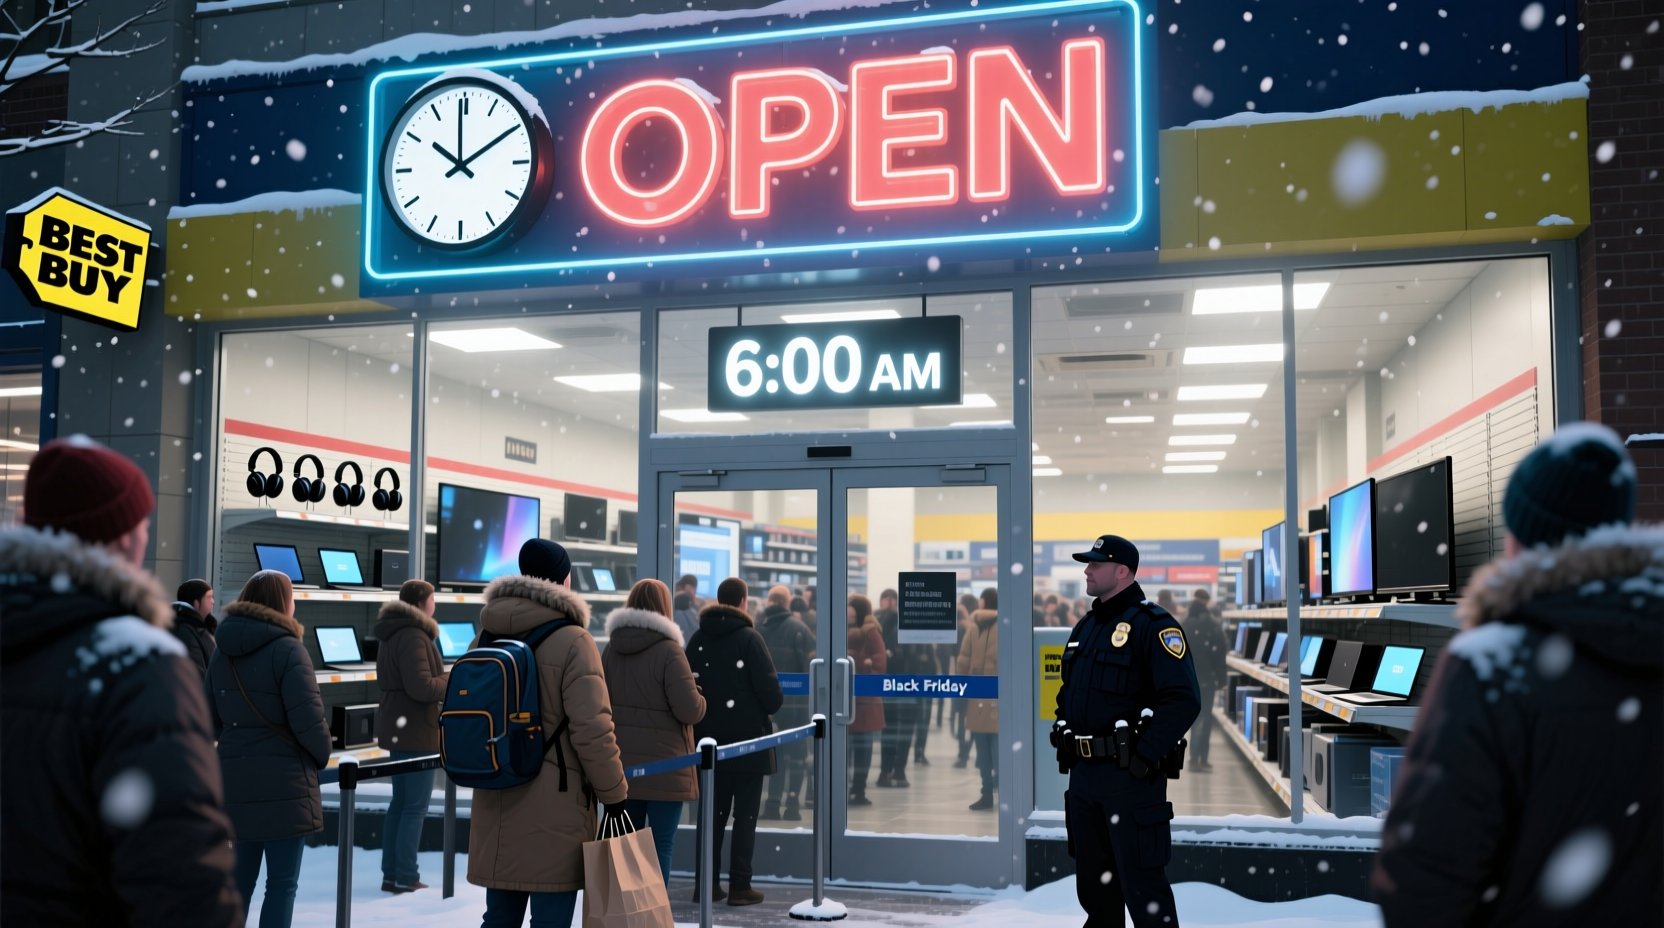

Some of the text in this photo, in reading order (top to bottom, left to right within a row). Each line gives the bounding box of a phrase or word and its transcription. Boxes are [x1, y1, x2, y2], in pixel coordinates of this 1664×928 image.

[579, 36, 1106, 228] OPEN
[38, 214, 143, 274] BEST
[37, 251, 132, 304] BUY
[725, 335, 941, 397] 6:00 AM
[882, 678, 968, 696] Black Friday
